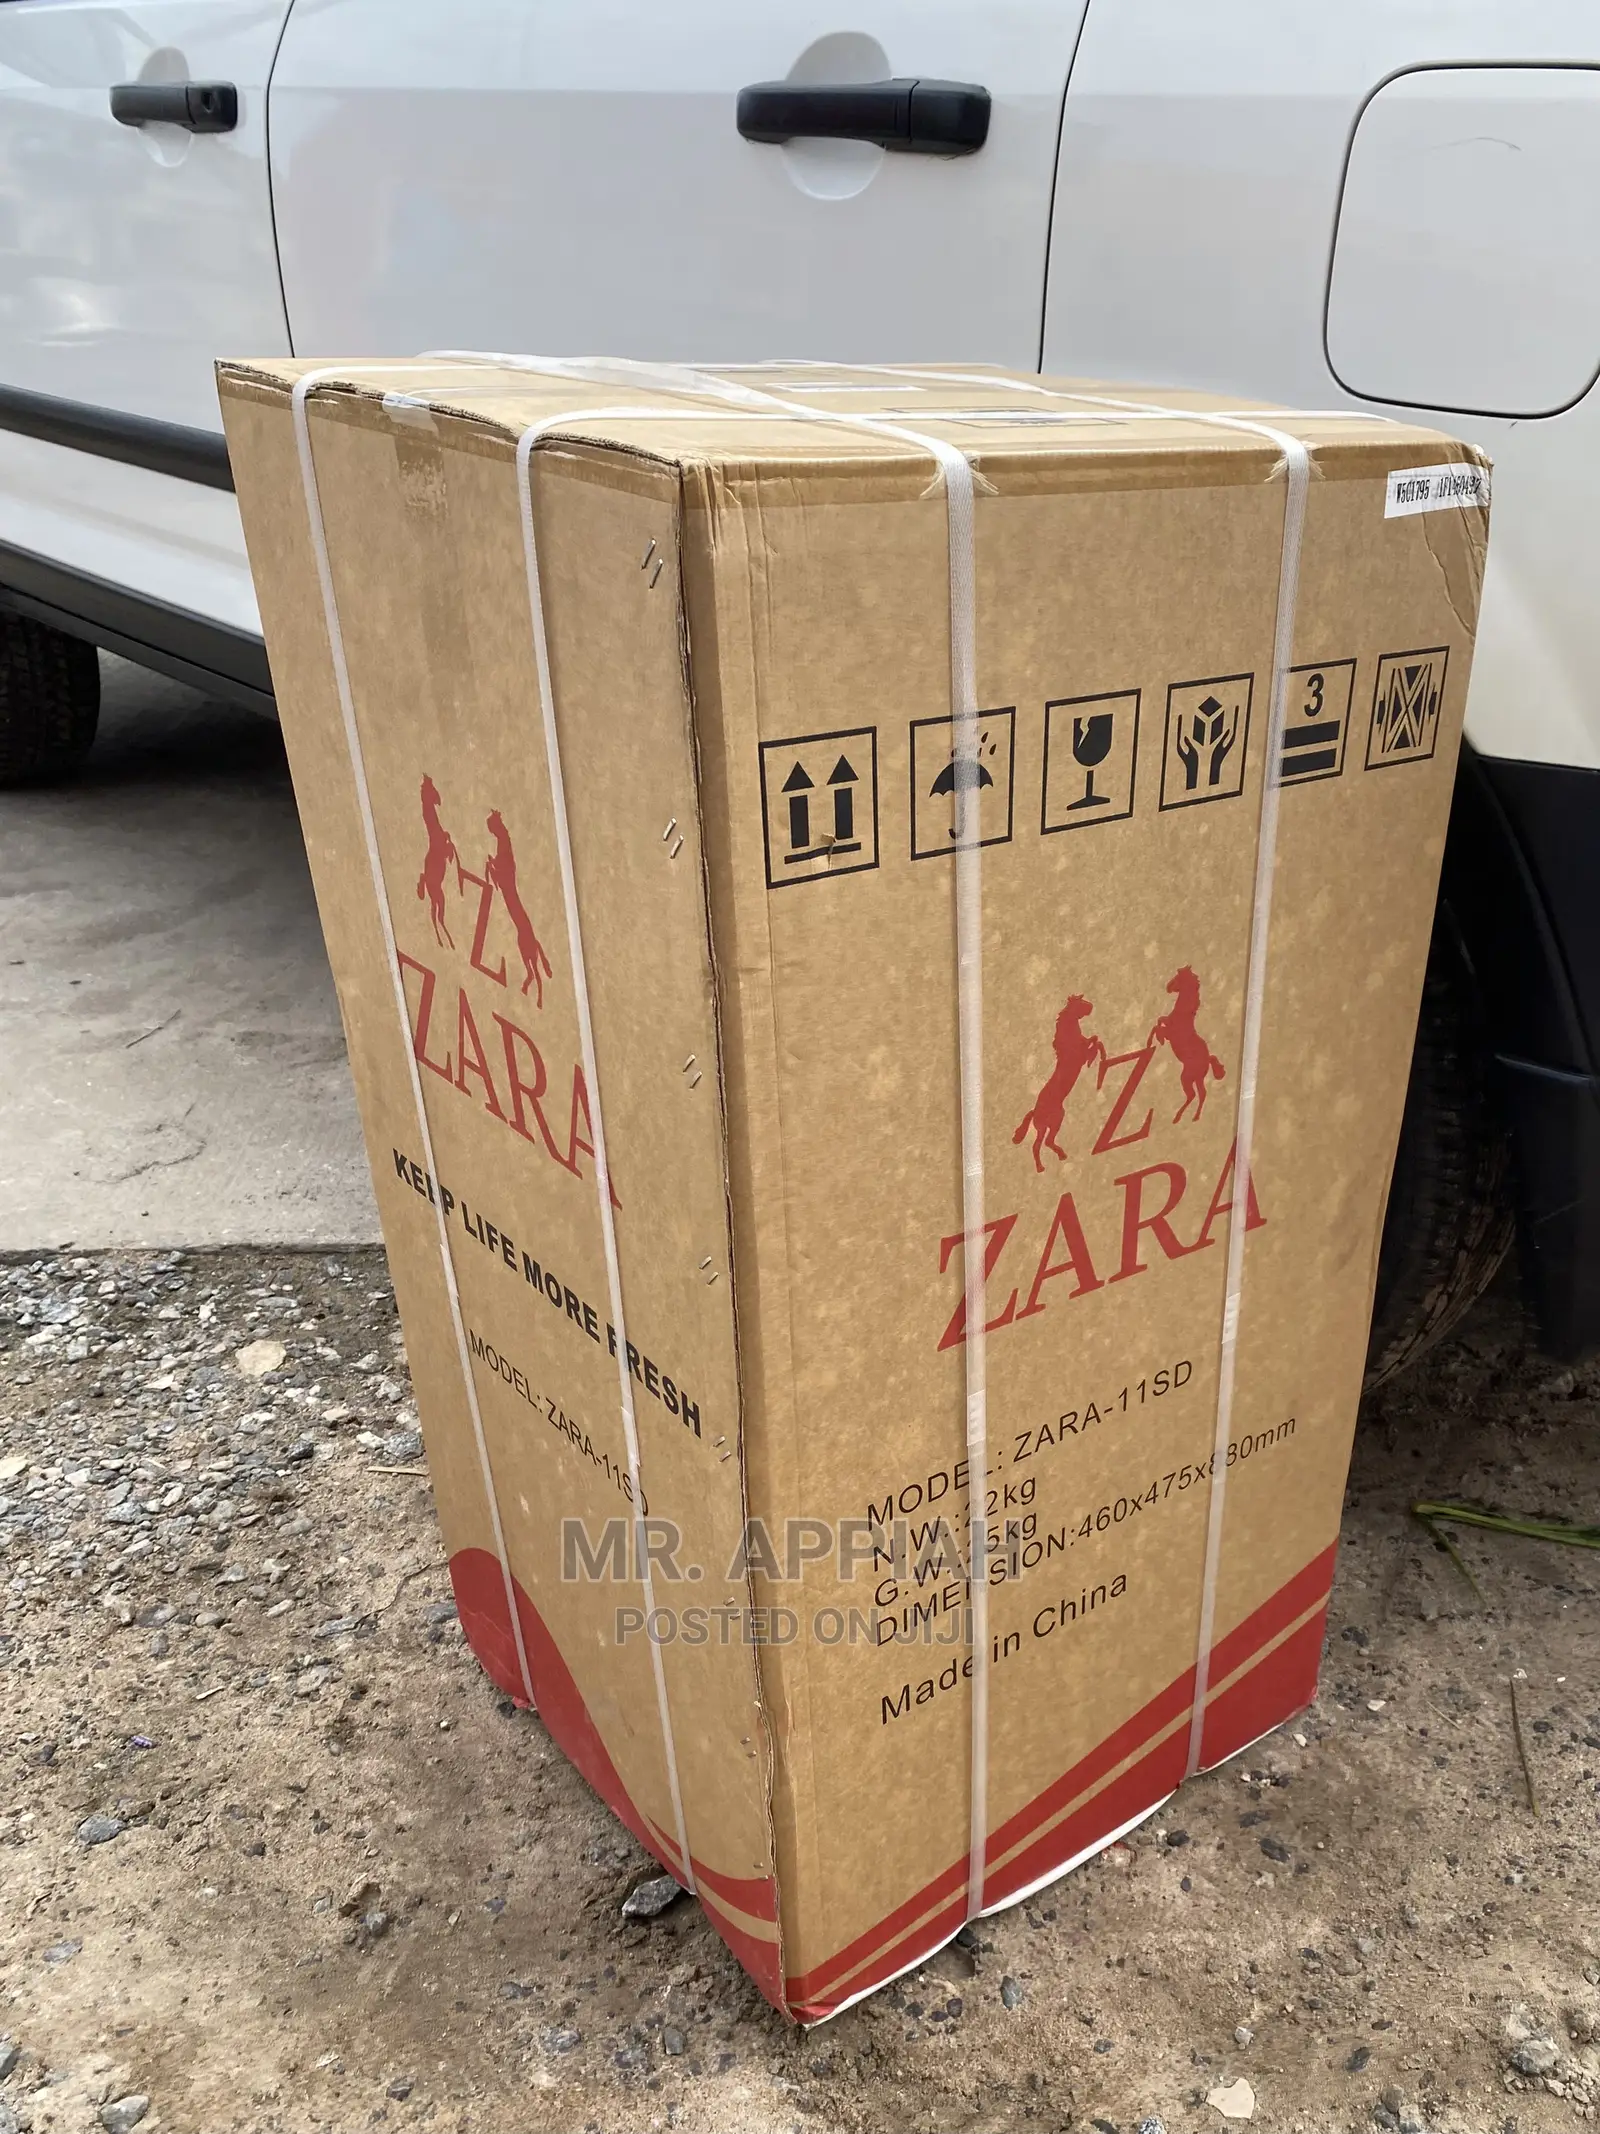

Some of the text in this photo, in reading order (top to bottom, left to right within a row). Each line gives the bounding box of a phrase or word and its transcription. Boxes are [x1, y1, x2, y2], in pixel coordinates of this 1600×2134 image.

[1303, 672, 1325, 718] 3
[396, 948, 622, 1211] ZARA
[937, 1136, 1267, 1352] ZARA
[461, 1200, 518, 1272] LIFE
[521, 1250, 600, 1343] MORE
[606, 1322, 701, 1440] FRESH
[469, 1328, 543, 1414] MODEL:
[1012, 1360, 1193, 1463] ZARA-11SD
[873, 1477, 1037, 1573] N.W.:2kg
[874, 1513, 1038, 1608] G.W.:5kg
[881, 1573, 1128, 1725] Made in China
